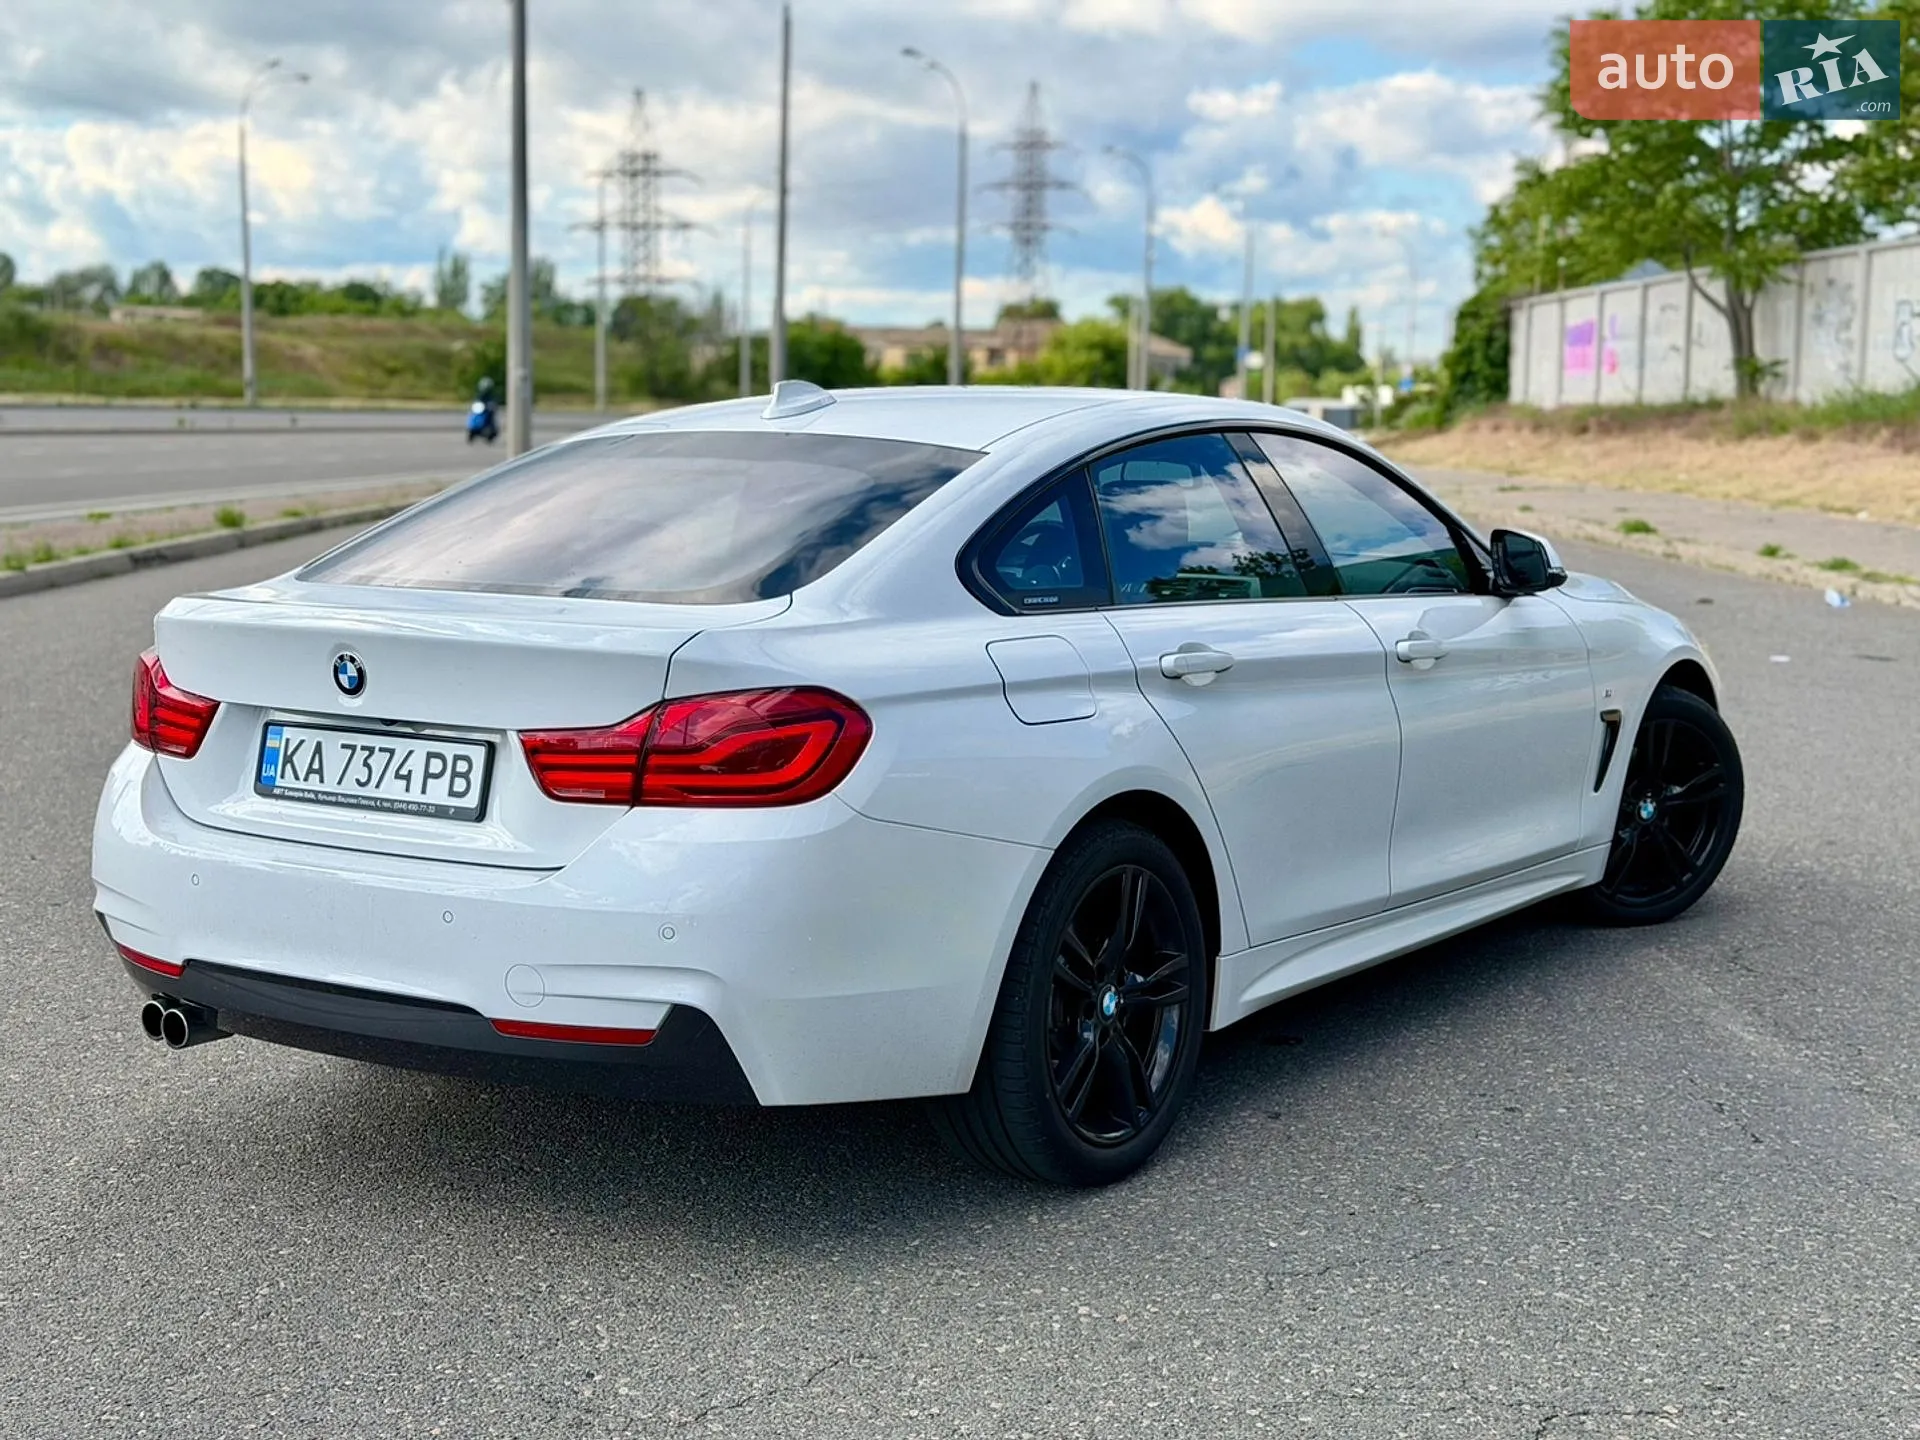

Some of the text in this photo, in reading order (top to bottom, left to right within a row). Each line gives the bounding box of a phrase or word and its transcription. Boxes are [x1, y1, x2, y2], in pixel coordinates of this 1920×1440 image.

[262, 763, 276, 778] UA
[279, 737, 474, 799] KA 7374 PB
